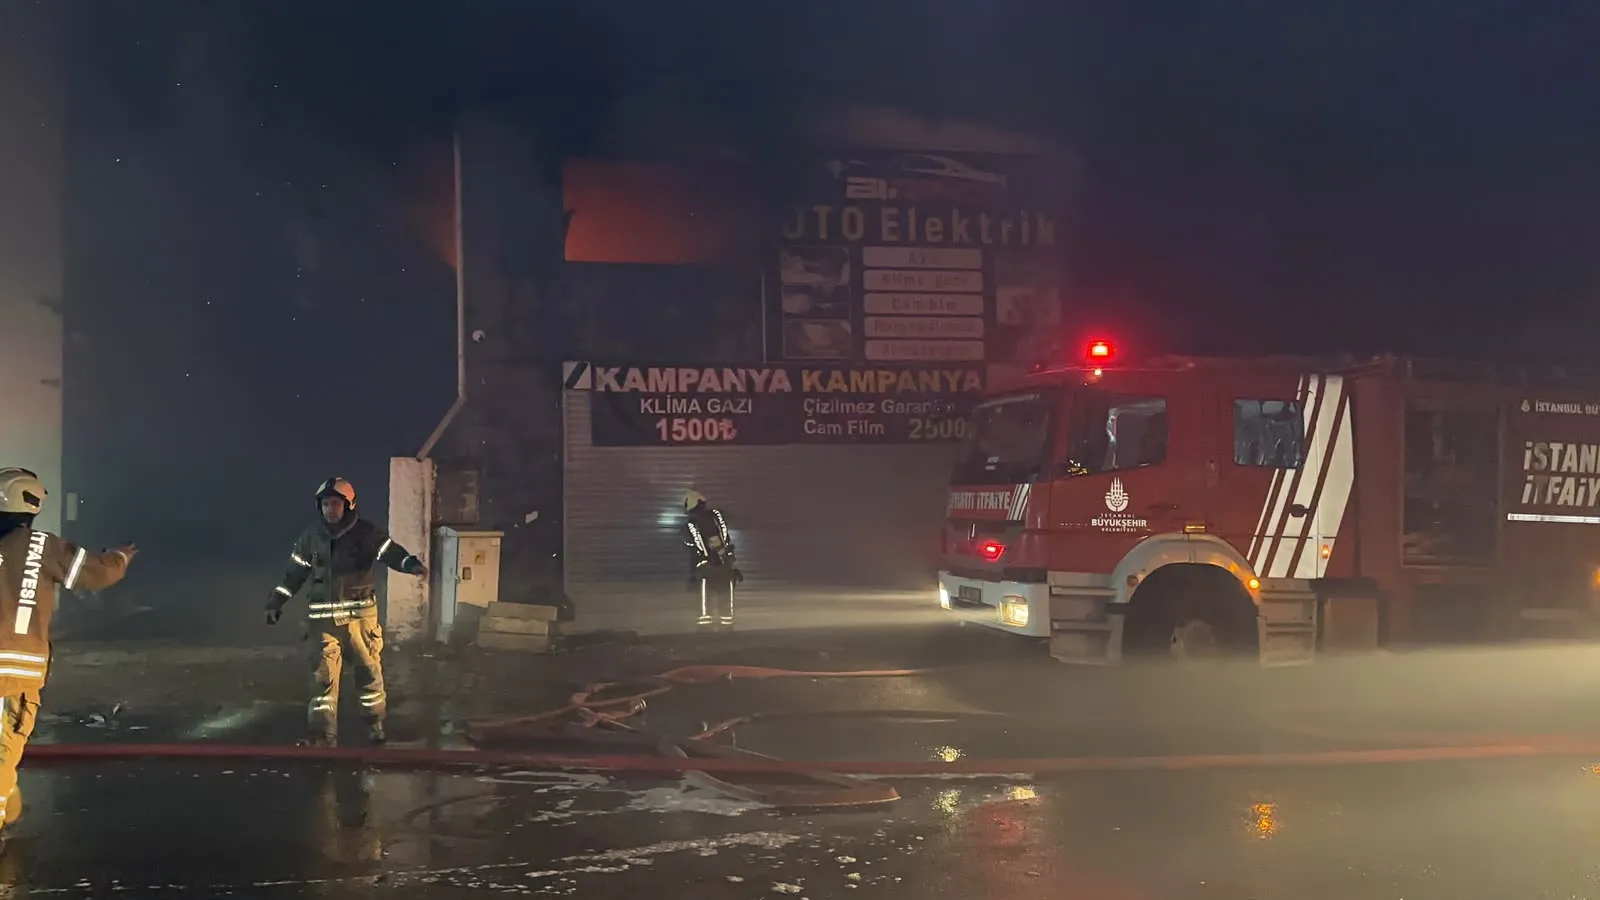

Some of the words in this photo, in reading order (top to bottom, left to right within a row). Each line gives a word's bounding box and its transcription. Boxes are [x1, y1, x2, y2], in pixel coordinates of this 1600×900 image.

[881, 206, 1057, 245] Elektrik
[595, 367, 793, 393] KAMPANYA
[801, 369, 982, 393] KAMPANYA
[640, 395, 702, 414] KLİMA
[707, 397, 753, 414] GAZI
[803, 398, 876, 417] Çizilmez
[804, 419, 842, 435] Cam
[847, 419, 885, 436] Film
[908, 417, 973, 440] 2500
